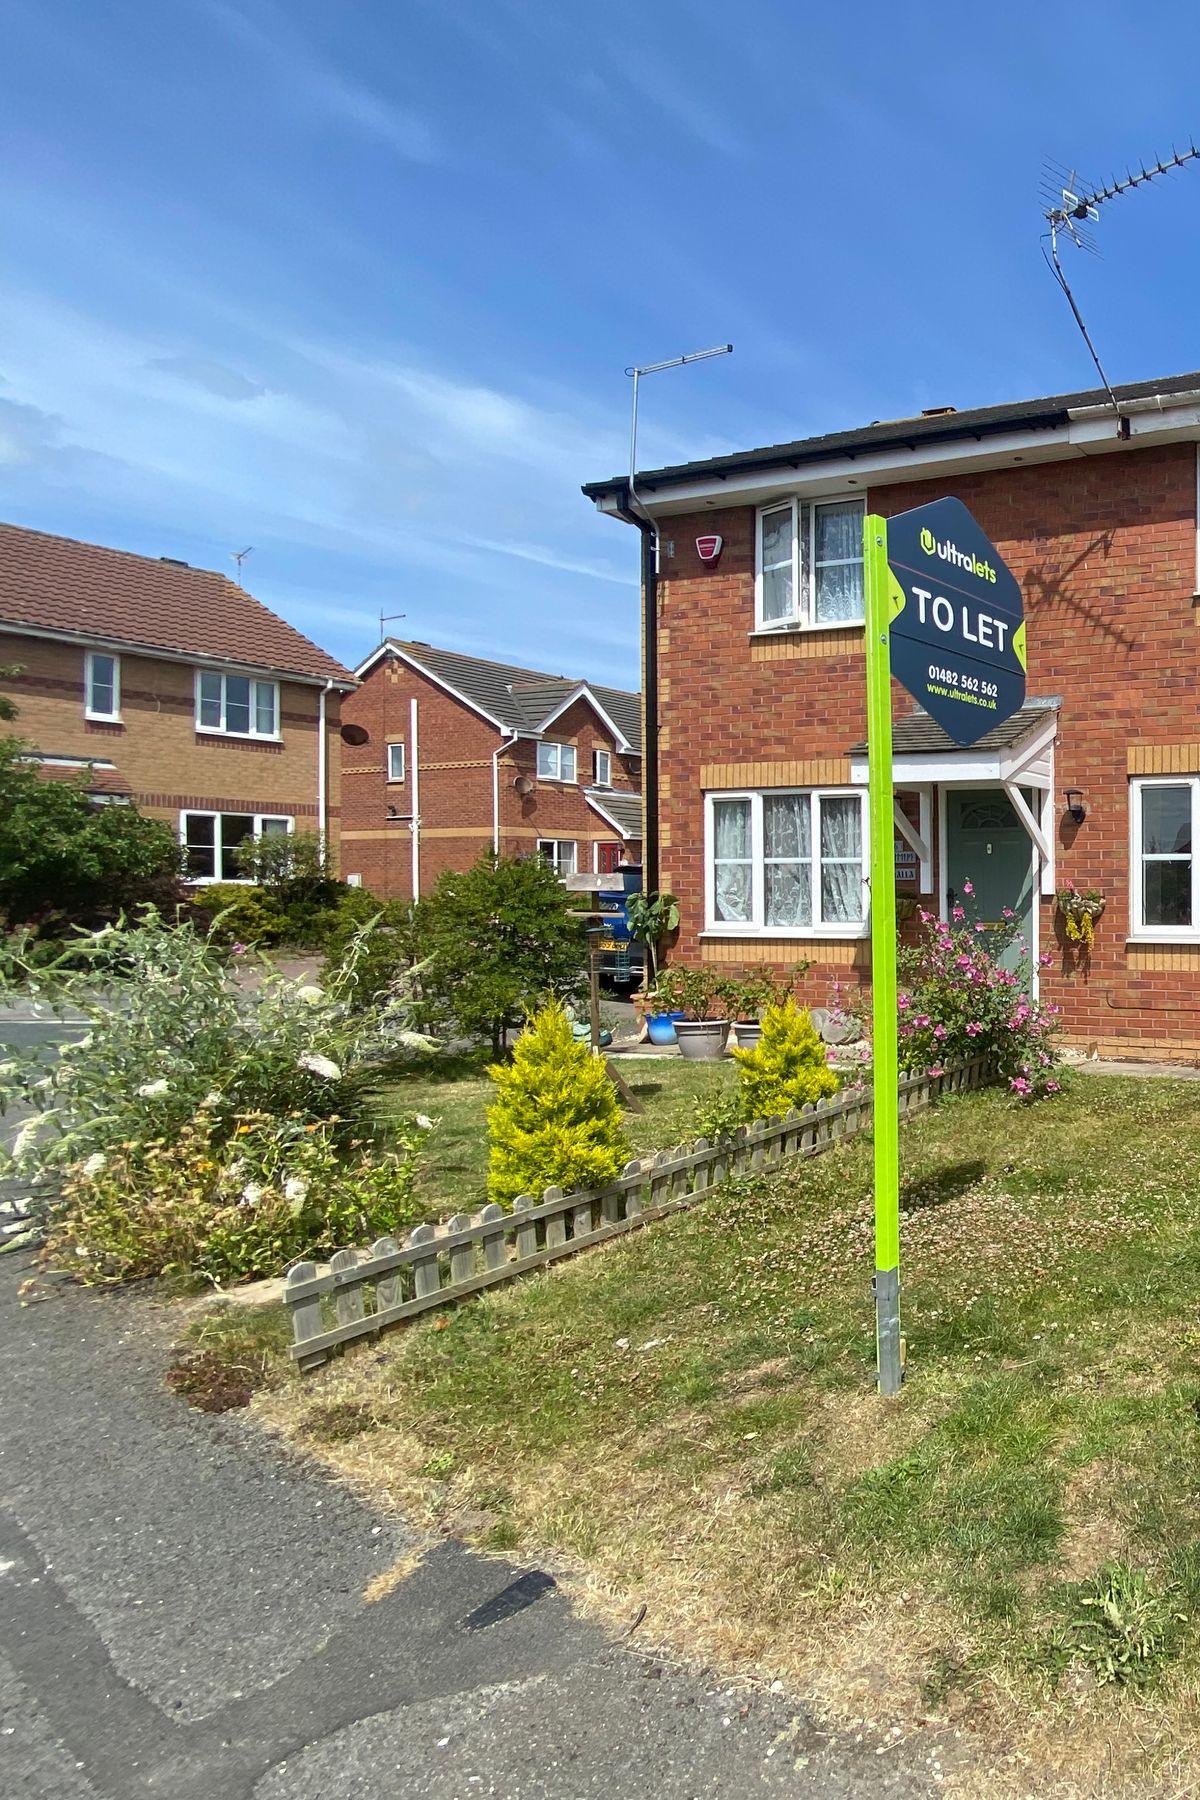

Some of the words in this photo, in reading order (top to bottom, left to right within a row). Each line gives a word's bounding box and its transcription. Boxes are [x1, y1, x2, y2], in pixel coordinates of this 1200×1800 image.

[937, 540, 997, 584] ultralets
[911, 586, 954, 632] TO
[962, 606, 1009, 652] LET
[926, 683, 997, 710] www.ultralets.co.uk
[928, 664, 959, 686] 01482
[961, 675, 979, 692] 562
[981, 681, 998, 698] 562
